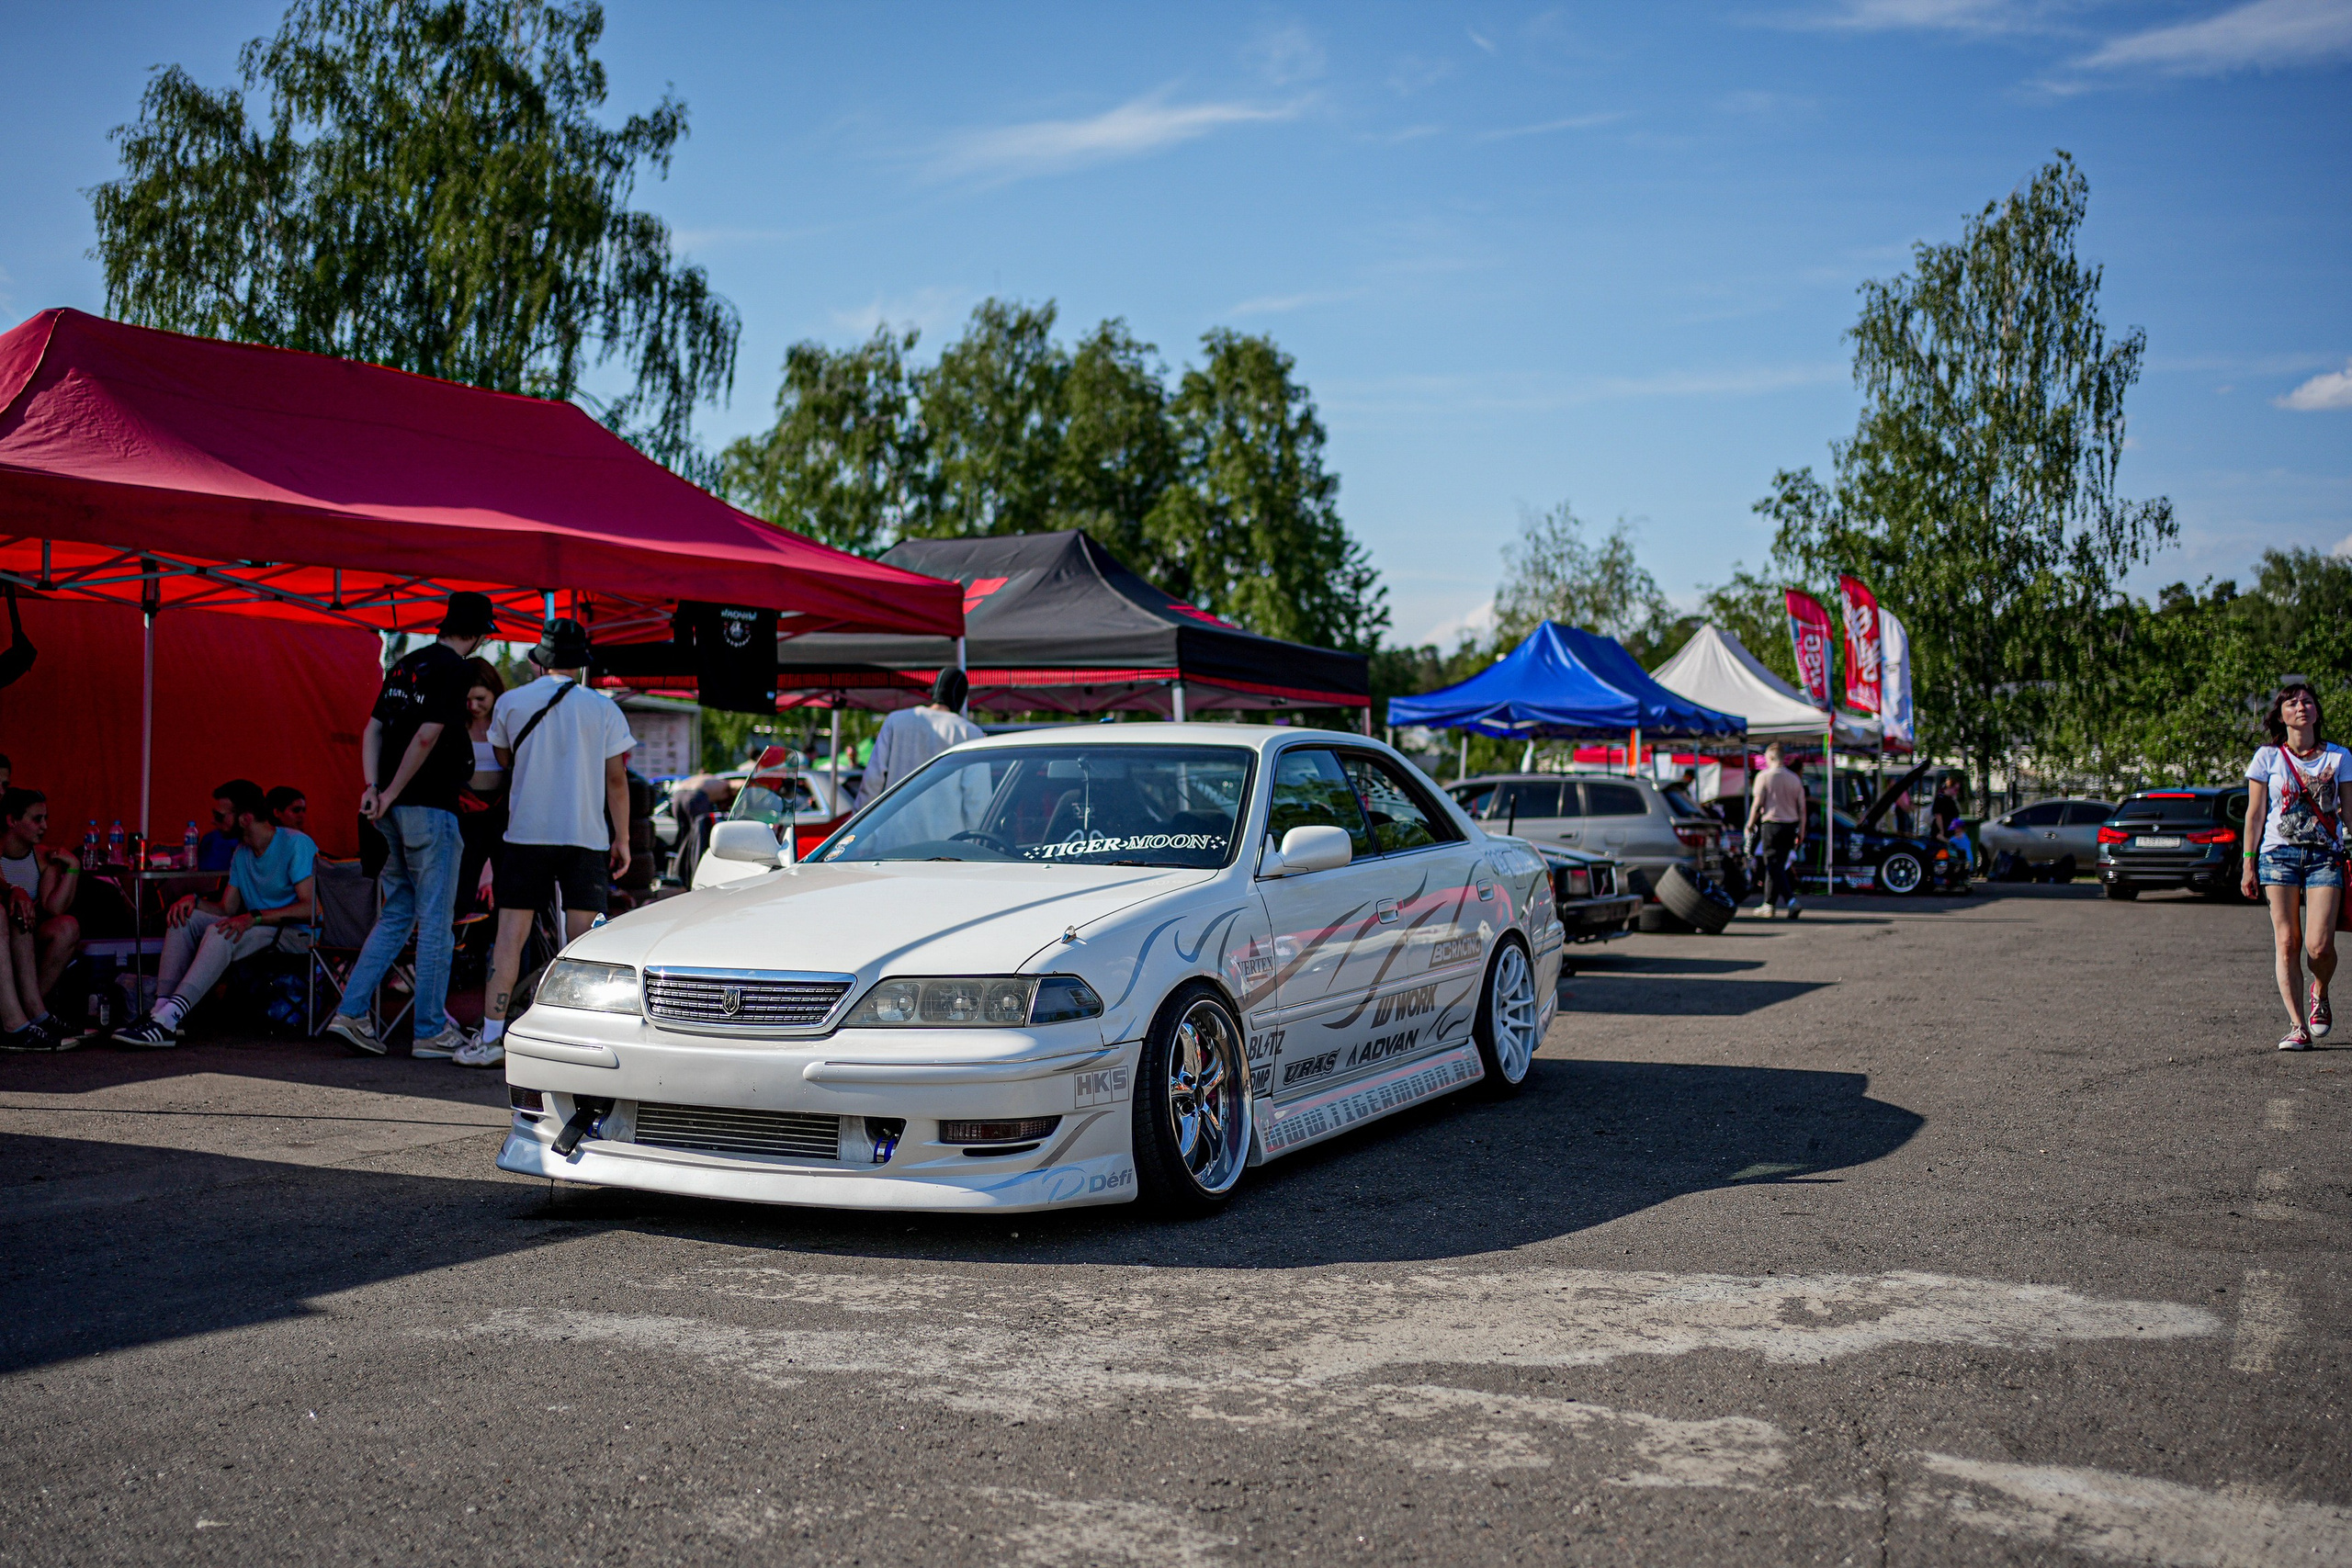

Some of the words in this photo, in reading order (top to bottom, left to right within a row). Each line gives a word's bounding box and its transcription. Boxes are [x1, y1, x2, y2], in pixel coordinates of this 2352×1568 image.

[1041, 837, 1122, 859] TIGER
[1125, 834, 1212, 851] MOON
[1237, 955, 1274, 976] VERTEX
[1395, 983, 1439, 1022] WORK
[1249, 1030, 1285, 1062] BLITZ
[1357, 1028, 1420, 1065] ADVAN
[1283, 1047, 1341, 1086] URAS
[1076, 1069, 1127, 1097] HKS
